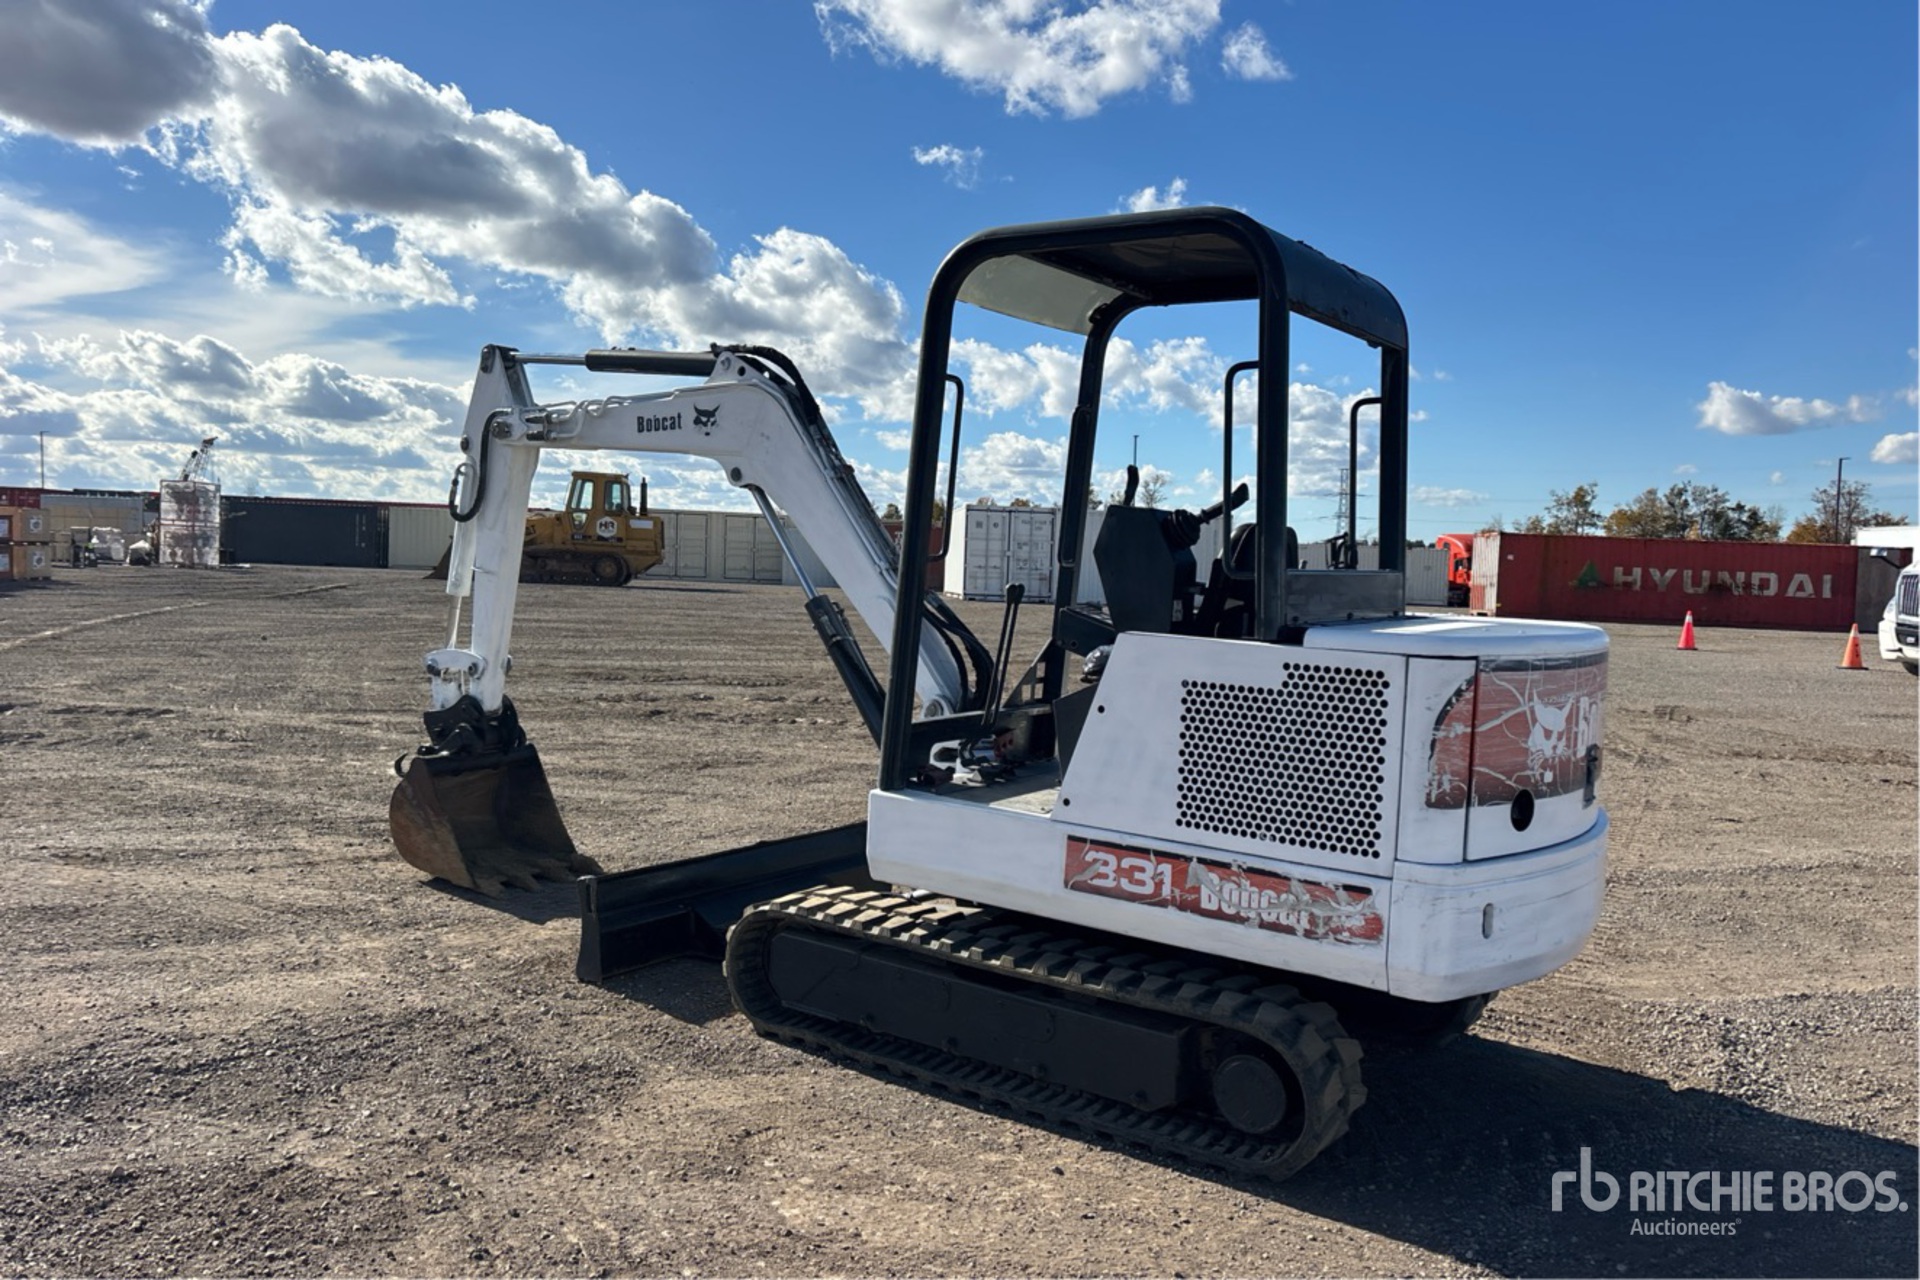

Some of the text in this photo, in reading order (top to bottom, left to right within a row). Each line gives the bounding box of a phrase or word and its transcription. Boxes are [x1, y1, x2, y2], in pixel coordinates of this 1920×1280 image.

[637, 412, 682, 433] Bobcat
[1613, 566, 1832, 599] HYUNDAI
[1084, 850, 1173, 900] 331
